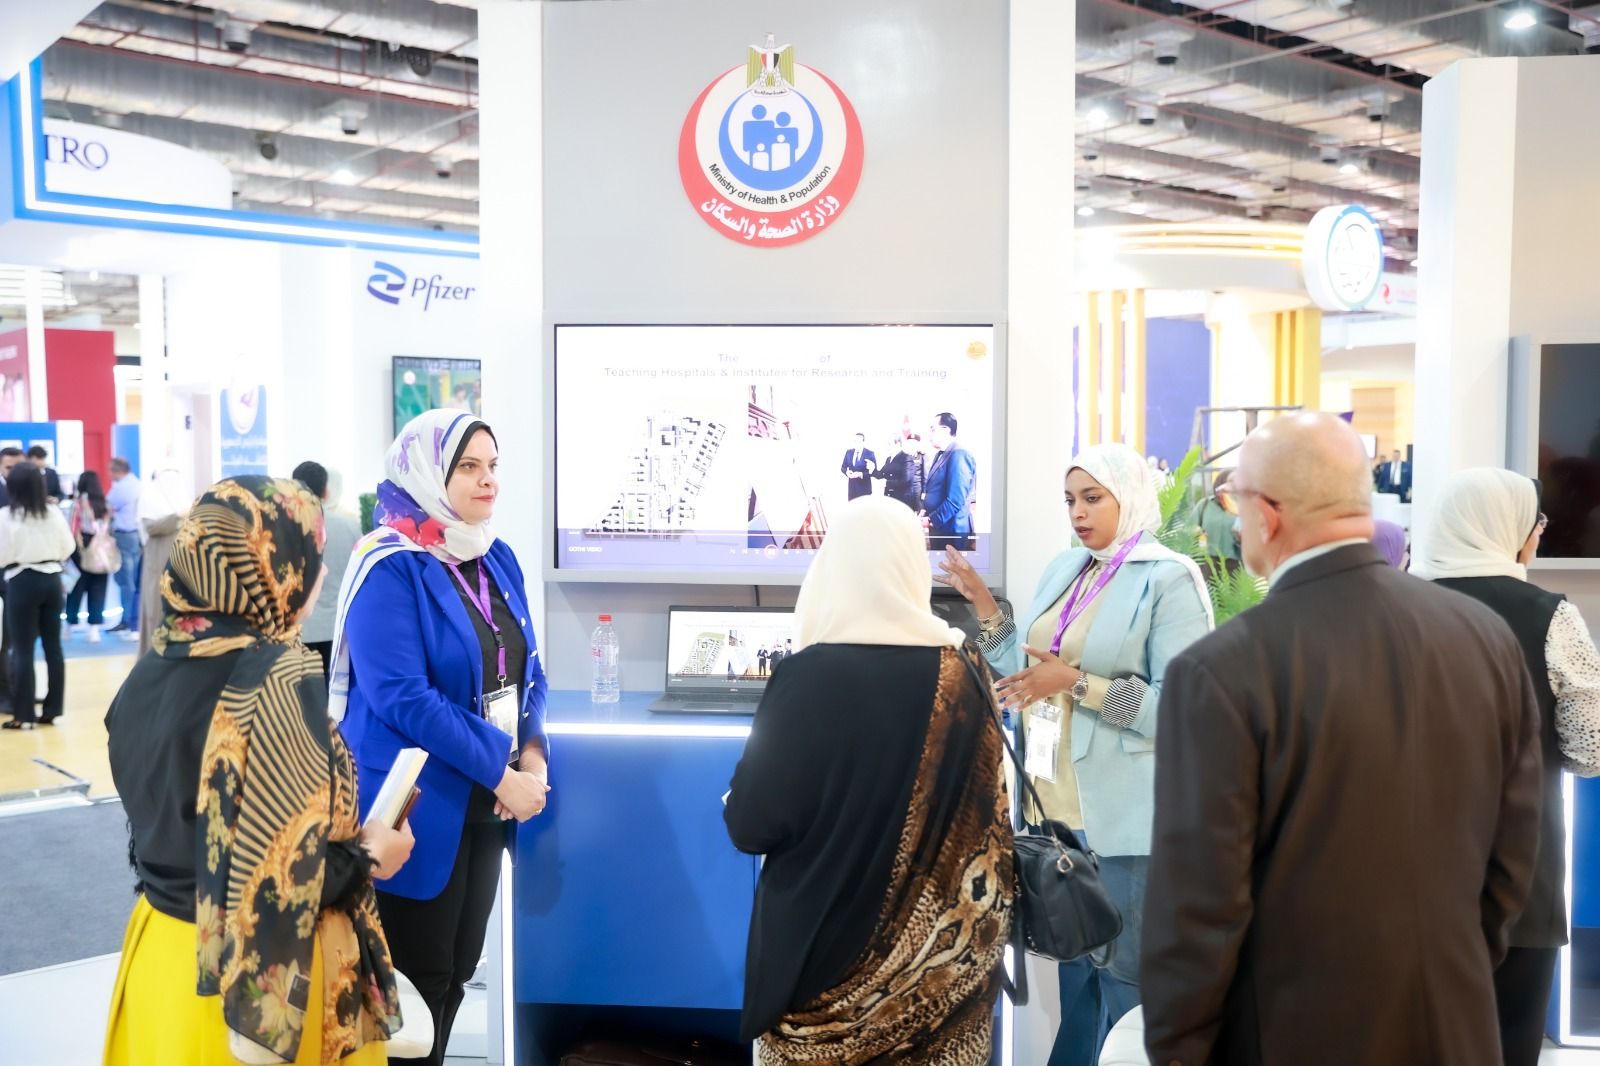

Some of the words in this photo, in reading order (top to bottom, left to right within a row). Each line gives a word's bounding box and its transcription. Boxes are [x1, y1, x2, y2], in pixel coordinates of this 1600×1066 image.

[709, 163, 738, 195] Ministry
[737, 191, 750, 200] of
[748, 193, 778, 205] Health
[780, 194, 789, 204] &
[788, 165, 832, 201] Population
[701, 197, 757, 240] والسكان
[758, 216, 804, 239] الصحة
[801, 195, 840, 230] وزارة
[411, 274, 476, 312] Pfizer
[604, 367, 657, 379] Teaching
[661, 367, 716, 379] Hospitals
[720, 368, 728, 377] &
[732, 367, 789, 377] Institutes
[791, 367, 808, 377] for
[811, 367, 868, 377] Research
[872, 368, 894, 377] and
[897, 367, 948, 380] Training
[718, 353, 739, 363] The
[818, 354, 831, 364] of
